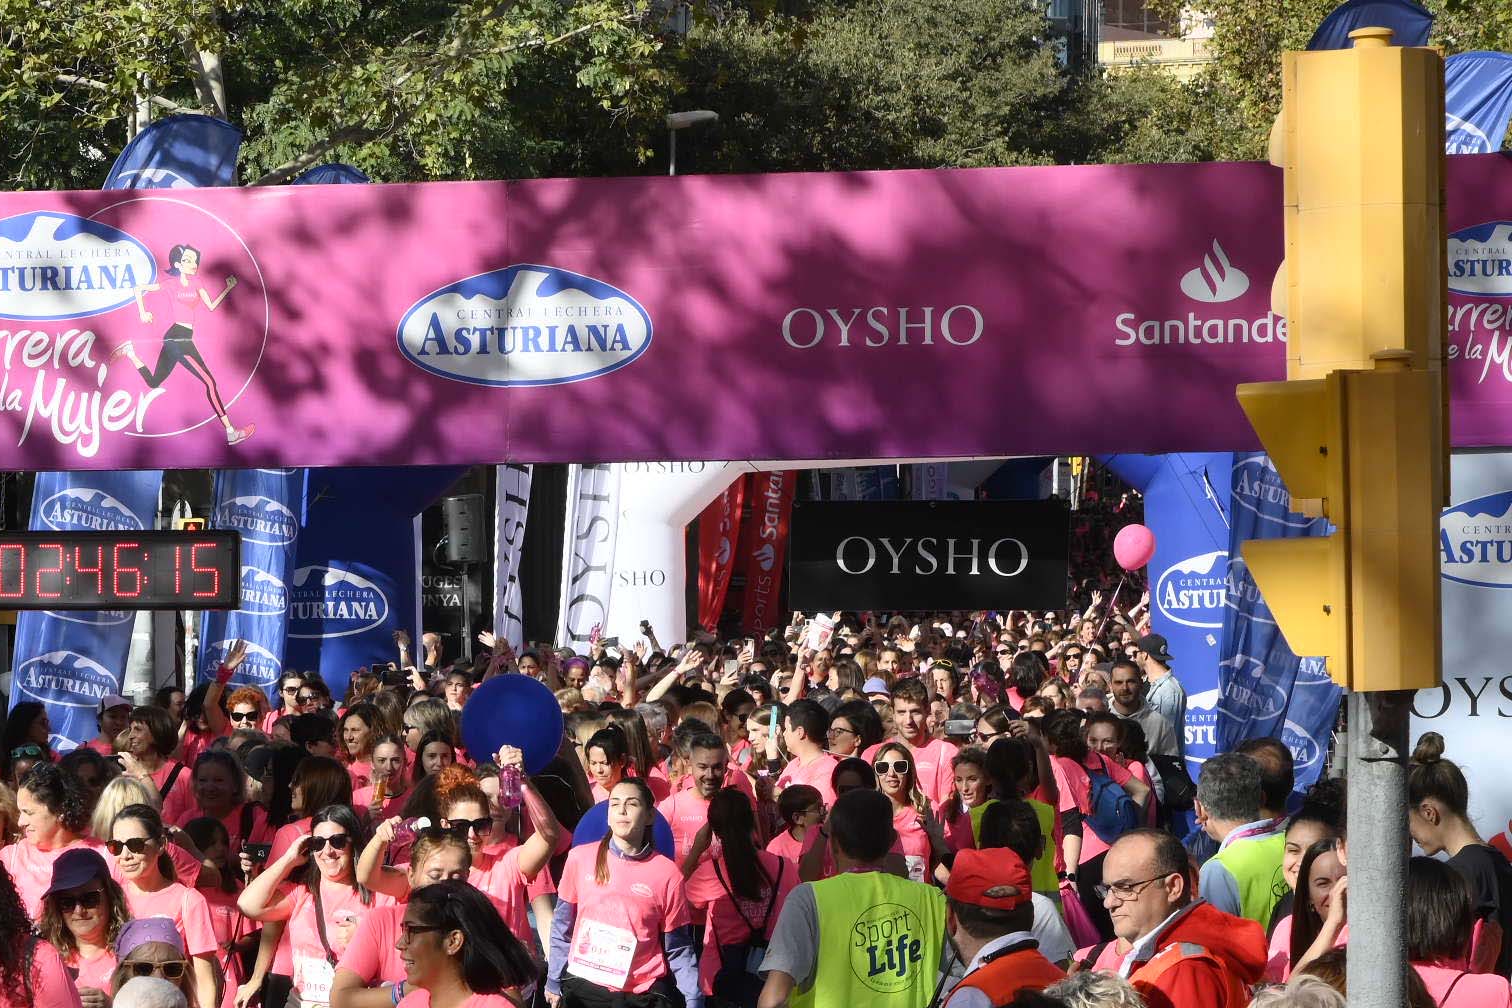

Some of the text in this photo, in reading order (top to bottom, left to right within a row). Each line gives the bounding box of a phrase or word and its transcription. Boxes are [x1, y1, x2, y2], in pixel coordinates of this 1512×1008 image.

[59, 247, 132, 259] LECHERA
[456, 308, 531, 321] CENTRAL
[781, 304, 985, 349] OYSHO
[1114, 311, 1287, 347] Santande
[416, 310, 633, 358] ASTURIANA
[1465, 341, 1482, 360] la
[0, 371, 23, 412] la
[17, 363, 166, 458] Mujer
[1462, 525, 1512, 535] CENTR
[836, 535, 1029, 577] OYSHO
[290, 601, 379, 620] TURIANA
[326, 590, 375, 599] LECHERA
[25, 668, 111, 698] ASTURIANA
[1411, 676, 1512, 719] OYS
[855, 911, 912, 948] Sport
[866, 933, 922, 978] Life
